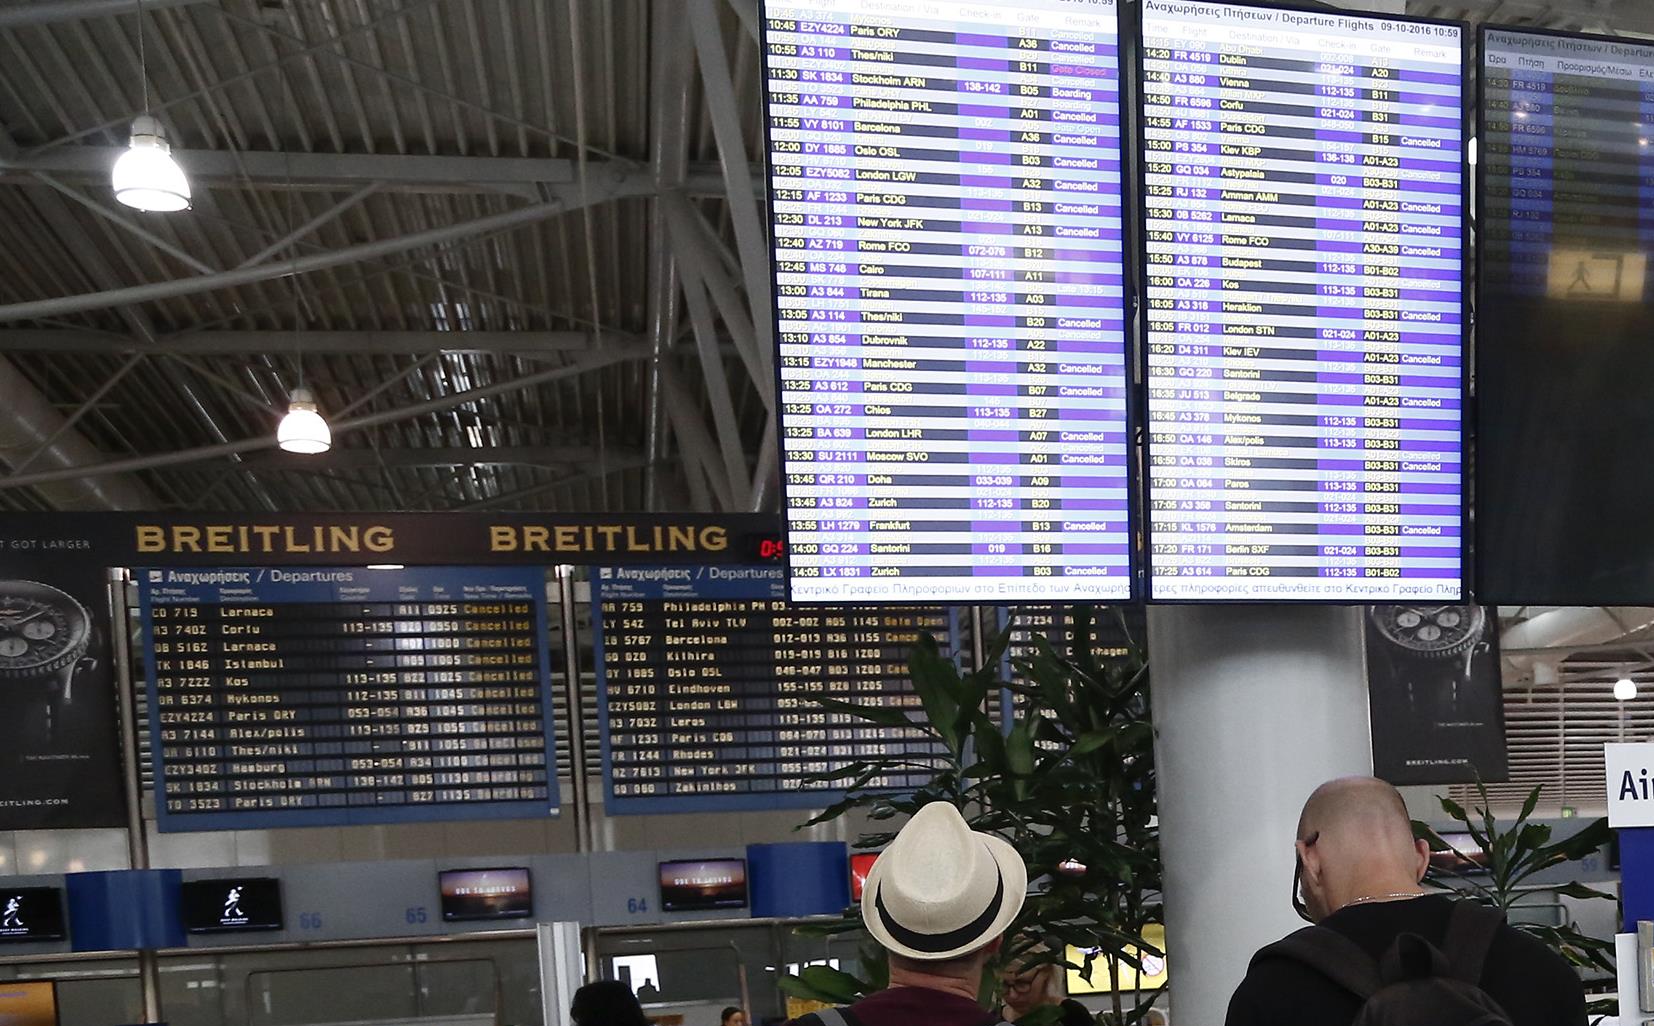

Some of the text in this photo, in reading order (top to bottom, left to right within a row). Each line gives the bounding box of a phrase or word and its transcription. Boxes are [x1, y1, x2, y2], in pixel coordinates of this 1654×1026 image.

[769, 20, 796, 31] 10:45
[800, 22, 845, 34] EZY4224
[850, 26, 875, 36] Paris
[877, 28, 900, 38] ORY
[1051, 41, 1095, 53] Cancelled
[1282, 13, 1335, 26] Departure
[1338, 18, 1374, 31] Flights
[1381, 22, 1431, 34] 09-10-2016
[1434, 27, 1458, 37] 10:59
[1146, 49, 1170, 59] 14:20
[1174, 51, 1187, 60] FR
[1190, 52, 1211, 62] 4519
[1219, 54, 1247, 65] Dublin
[1371, 69, 1388, 78] A20
[771, 68, 798, 79] 11:30
[802, 71, 817, 81] SK
[852, 73, 901, 86] Stockholm
[903, 77, 926, 88] ARN
[1020, 86, 1039, 96] B05
[1052, 88, 1092, 100] Boarding
[1148, 187, 1172, 196] 15:25
[1191, 190, 1207, 198] 132
[1221, 191, 1255, 201] Amman
[1255, 194, 1279, 203] AMM
[1363, 200, 1399, 210] A01-A23
[1401, 202, 1441, 213] Cancelled
[777, 214, 1100, 238] 12:30 DL 213 New York JFK A13 Cancelled
[136, 525, 395, 553] BREITLING
[489, 525, 728, 552] BREITLING
[271, 569, 353, 583] Departures
[709, 566, 784, 580] Departures
[793, 567, 1108, 577] 14:05 LX 1831 Zurich B03 Cancelled
[1226, 568, 1247, 576] Paris
[1249, 568, 1270, 576] CDG
[1325, 569, 1357, 577] 112-135
[1364, 569, 1400, 577] B01-B02
[627, 897, 647, 914] 64
